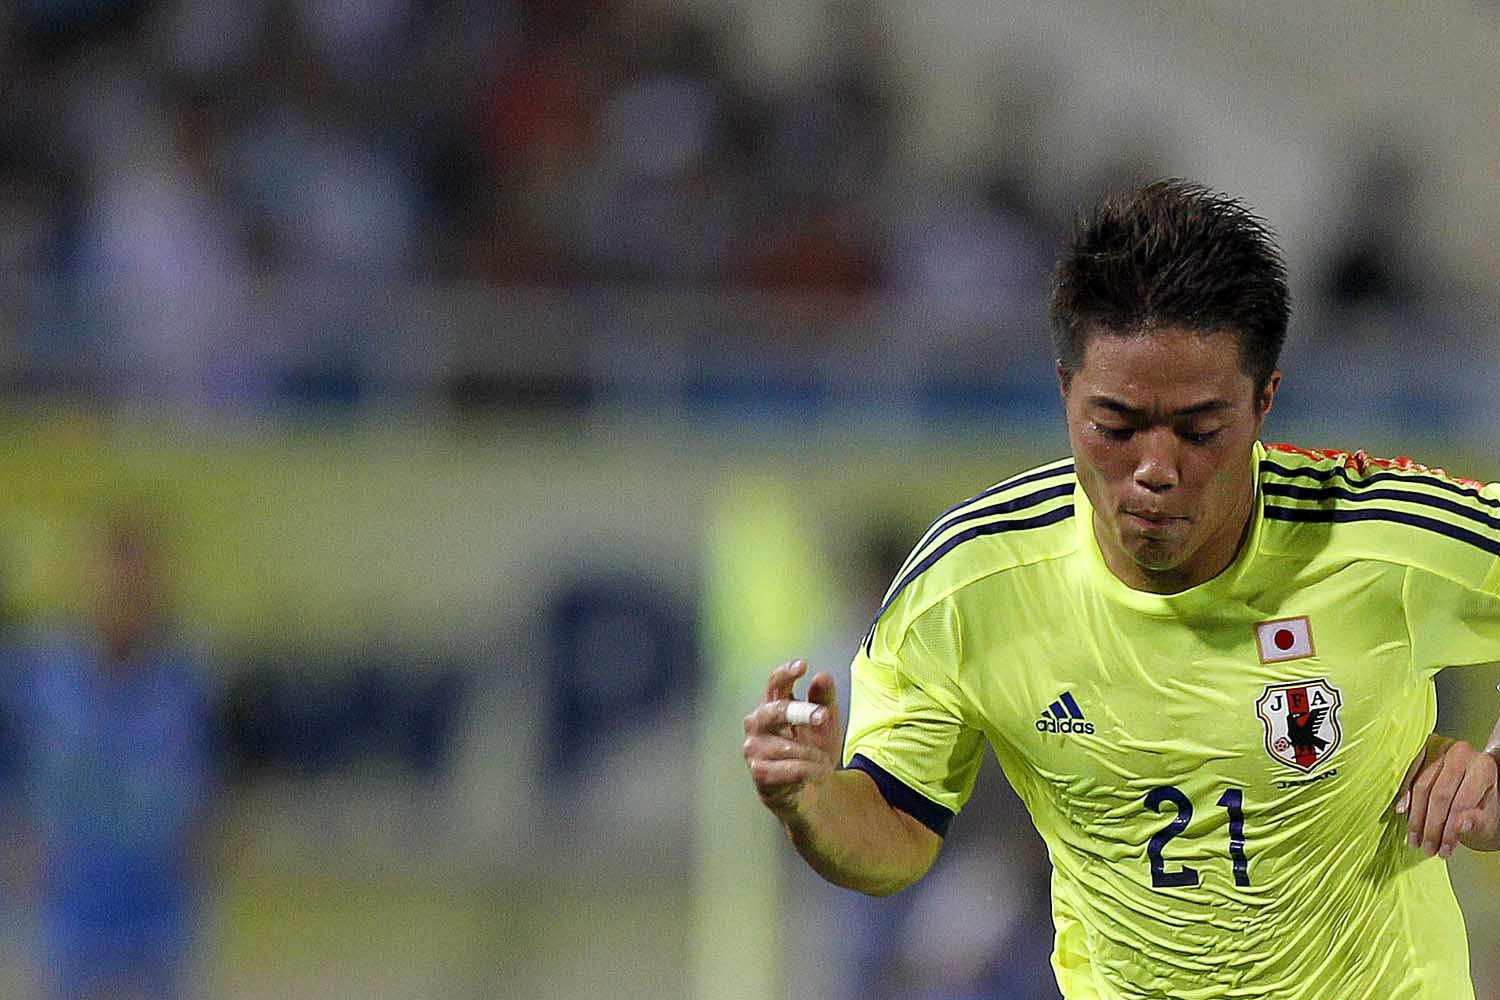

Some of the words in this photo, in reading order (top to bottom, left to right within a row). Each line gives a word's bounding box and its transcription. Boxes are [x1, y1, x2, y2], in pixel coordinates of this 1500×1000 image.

[1270, 689, 1328, 711] JFA
[1035, 717, 1095, 735] adidas
[1143, 785, 1251, 888] 21
